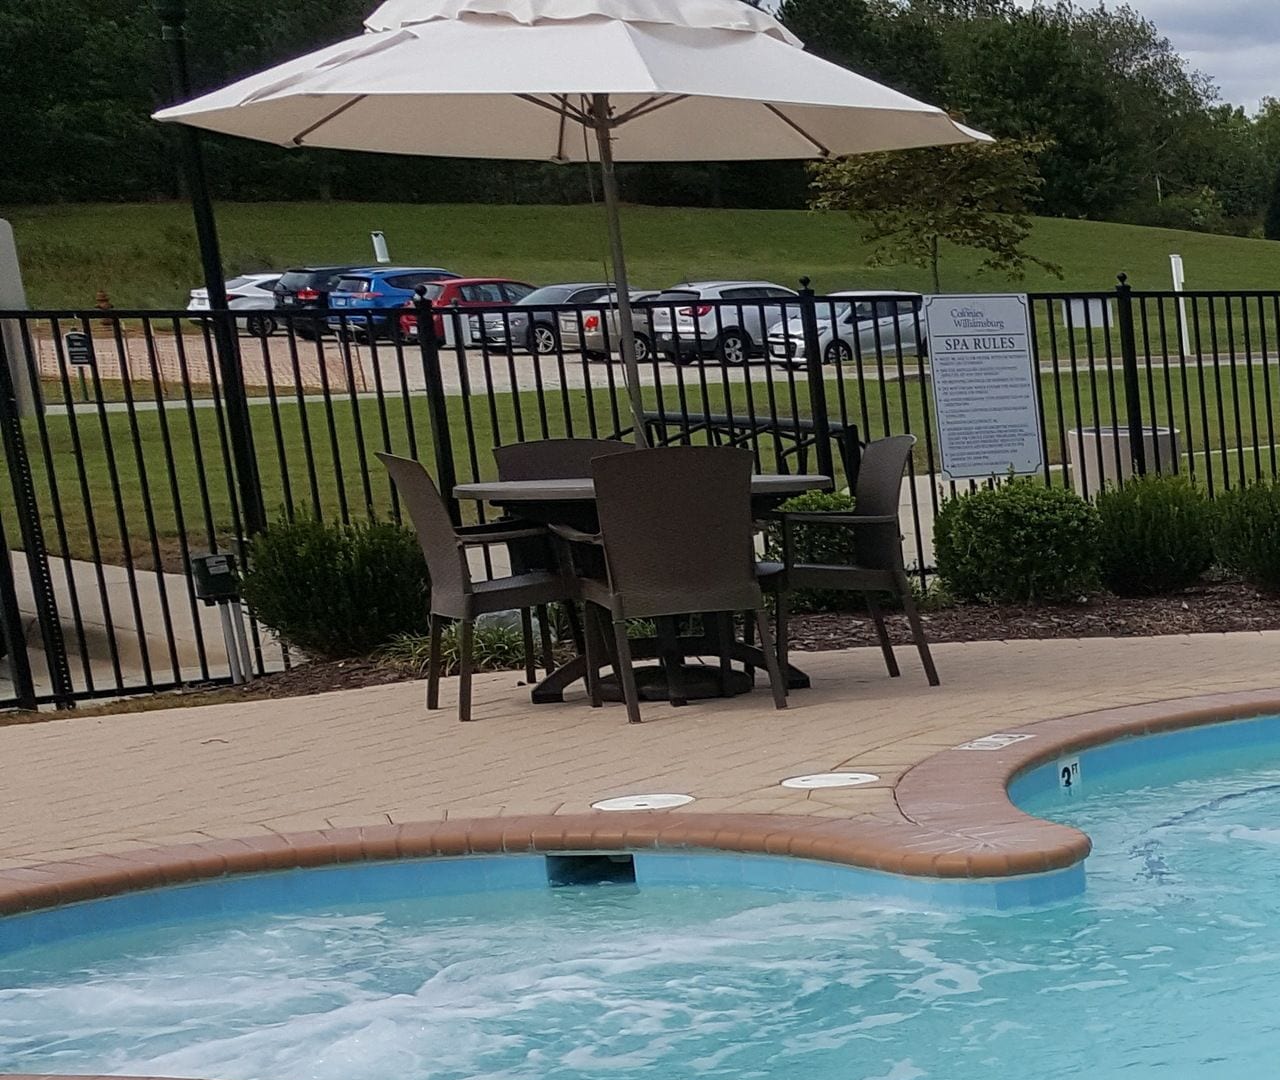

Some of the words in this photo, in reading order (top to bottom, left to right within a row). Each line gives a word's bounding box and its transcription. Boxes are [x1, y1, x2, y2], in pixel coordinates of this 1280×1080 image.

[953, 319, 1005, 330] Williamsburg
[945, 338, 969, 351] SPA
[973, 337, 1015, 350] RULES
[1071, 763, 1078, 775] FT
